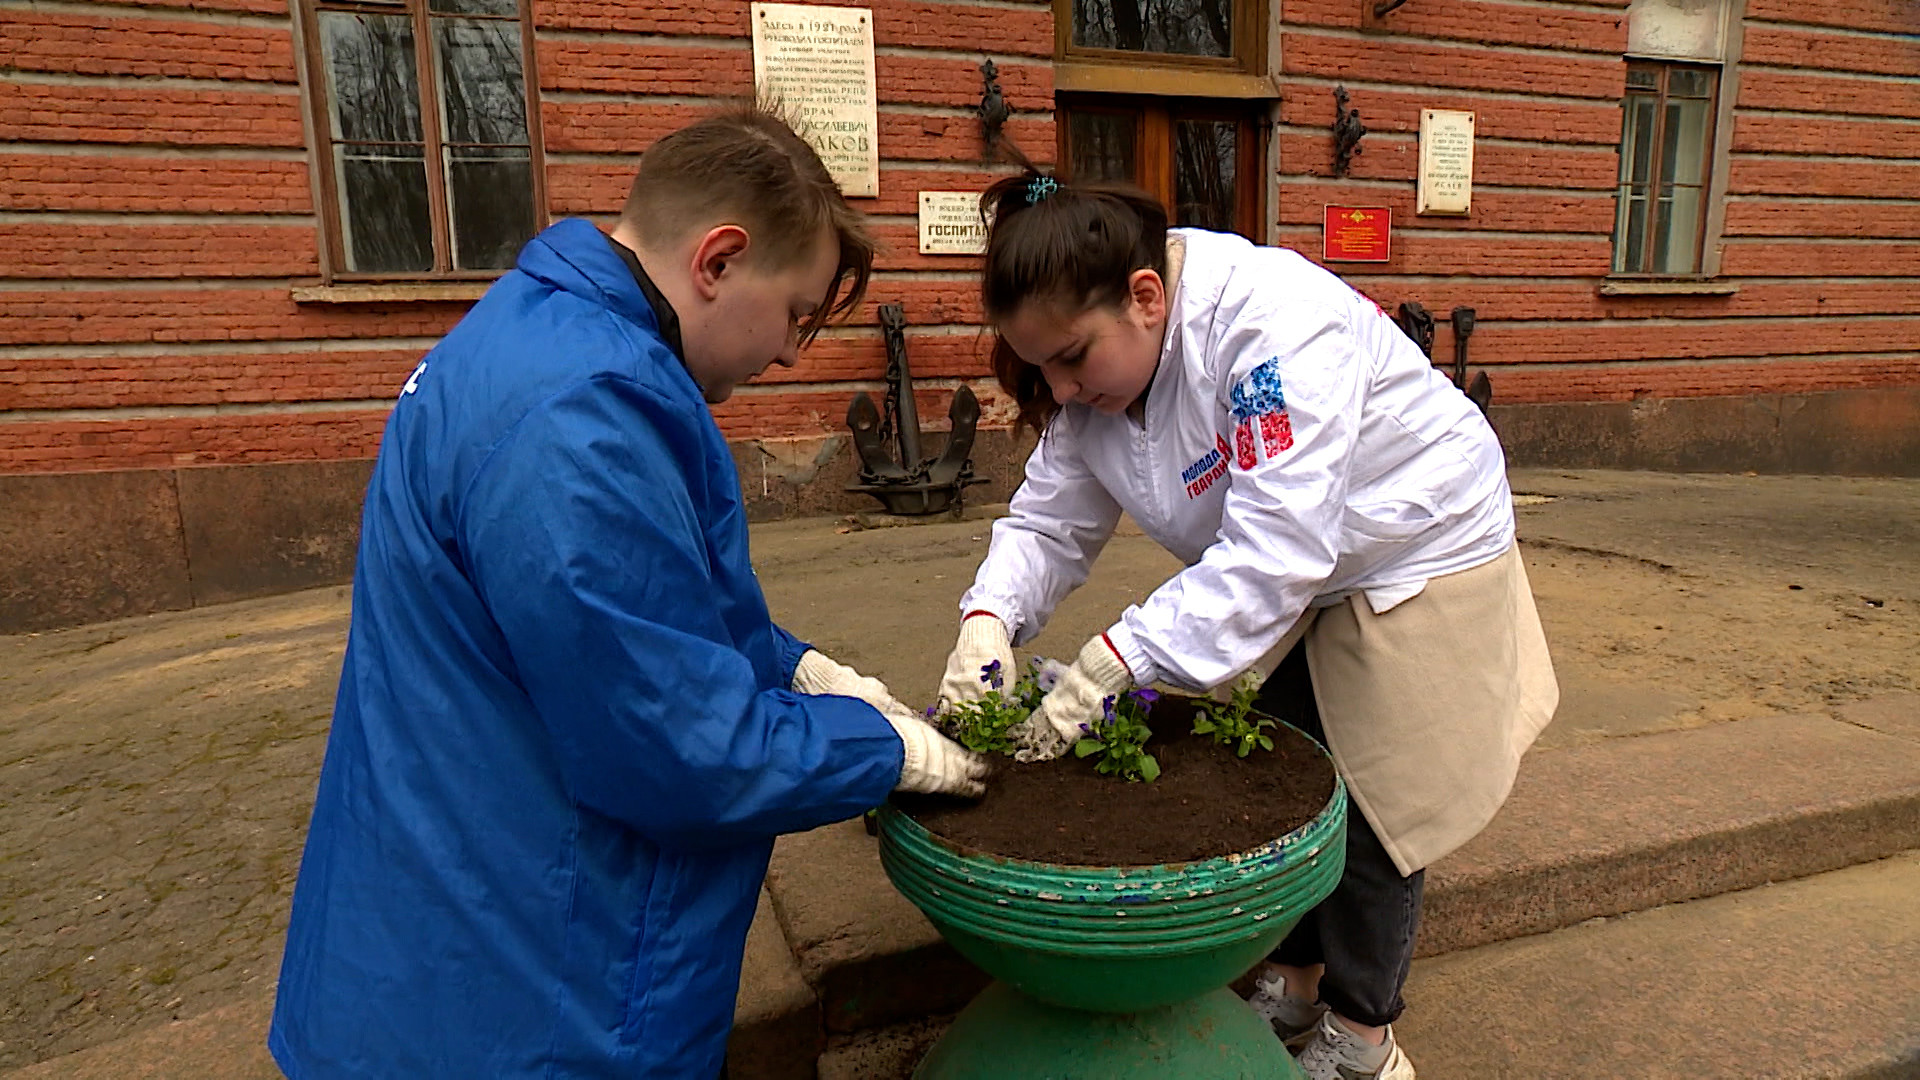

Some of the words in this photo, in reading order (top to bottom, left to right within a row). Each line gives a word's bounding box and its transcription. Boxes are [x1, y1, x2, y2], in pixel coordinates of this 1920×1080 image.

[803, 107, 834, 116] ВРАЧ
[801, 120, 868, 132] ВАСИЛЬЕВИЧ
[815, 135, 869, 152] АКОВ
